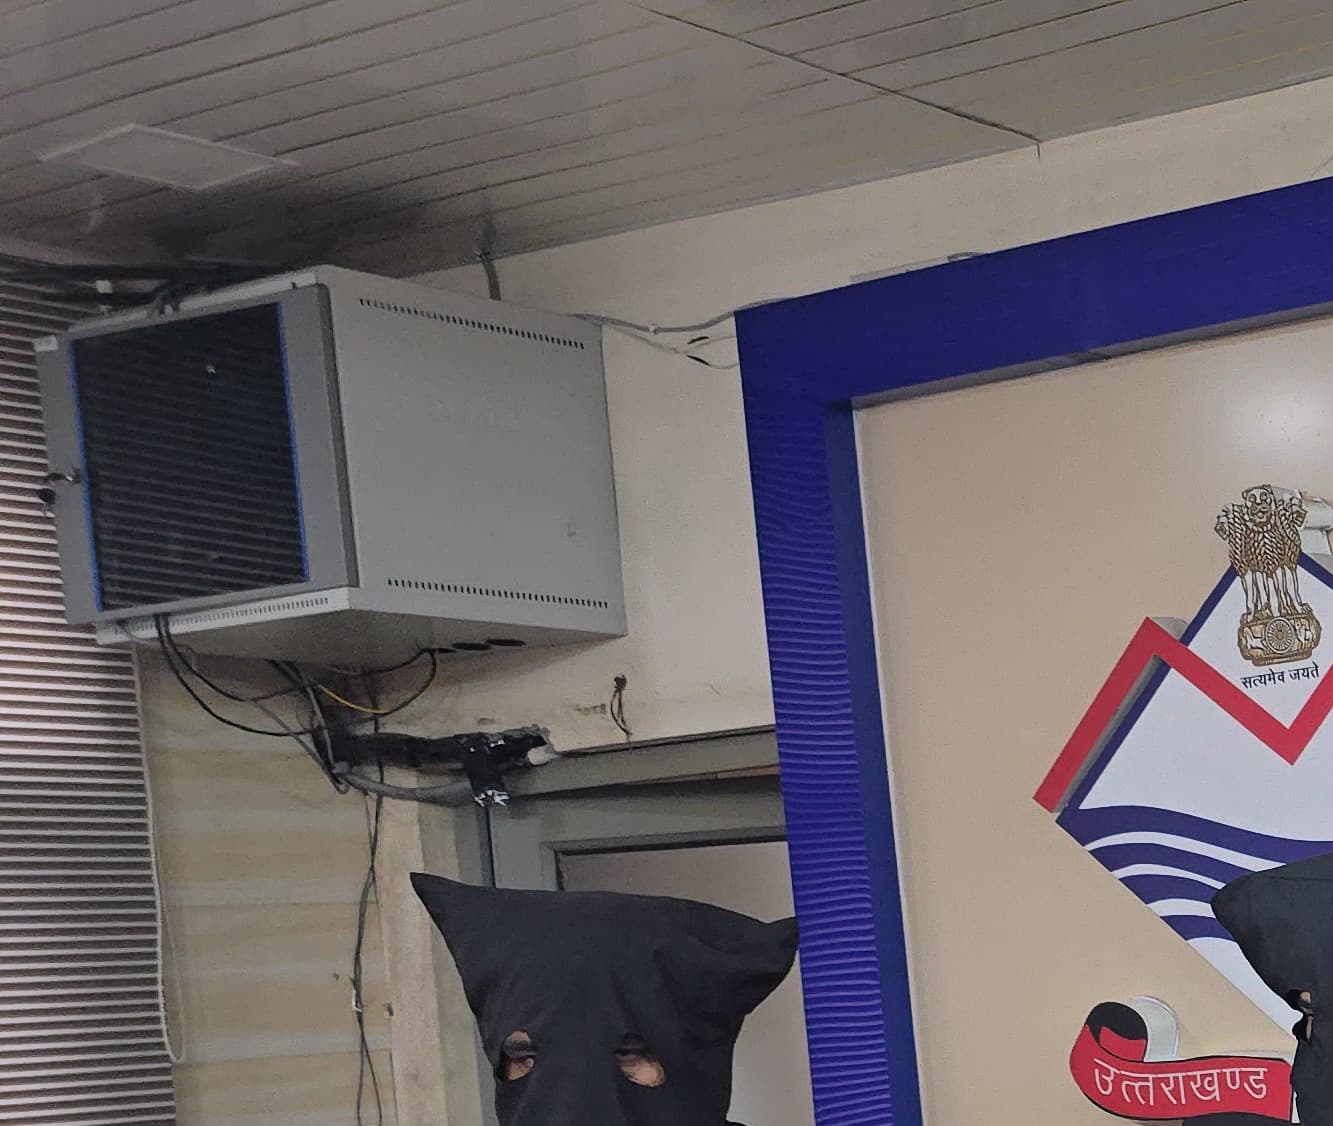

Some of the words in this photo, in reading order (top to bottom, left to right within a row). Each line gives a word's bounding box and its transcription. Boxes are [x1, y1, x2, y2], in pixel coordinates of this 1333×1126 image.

[1240, 668, 1285, 689] सत्यमेव
[1288, 661, 1319, 681] जयते
[1093, 1057, 1268, 1106] उत्तराखण्ड
